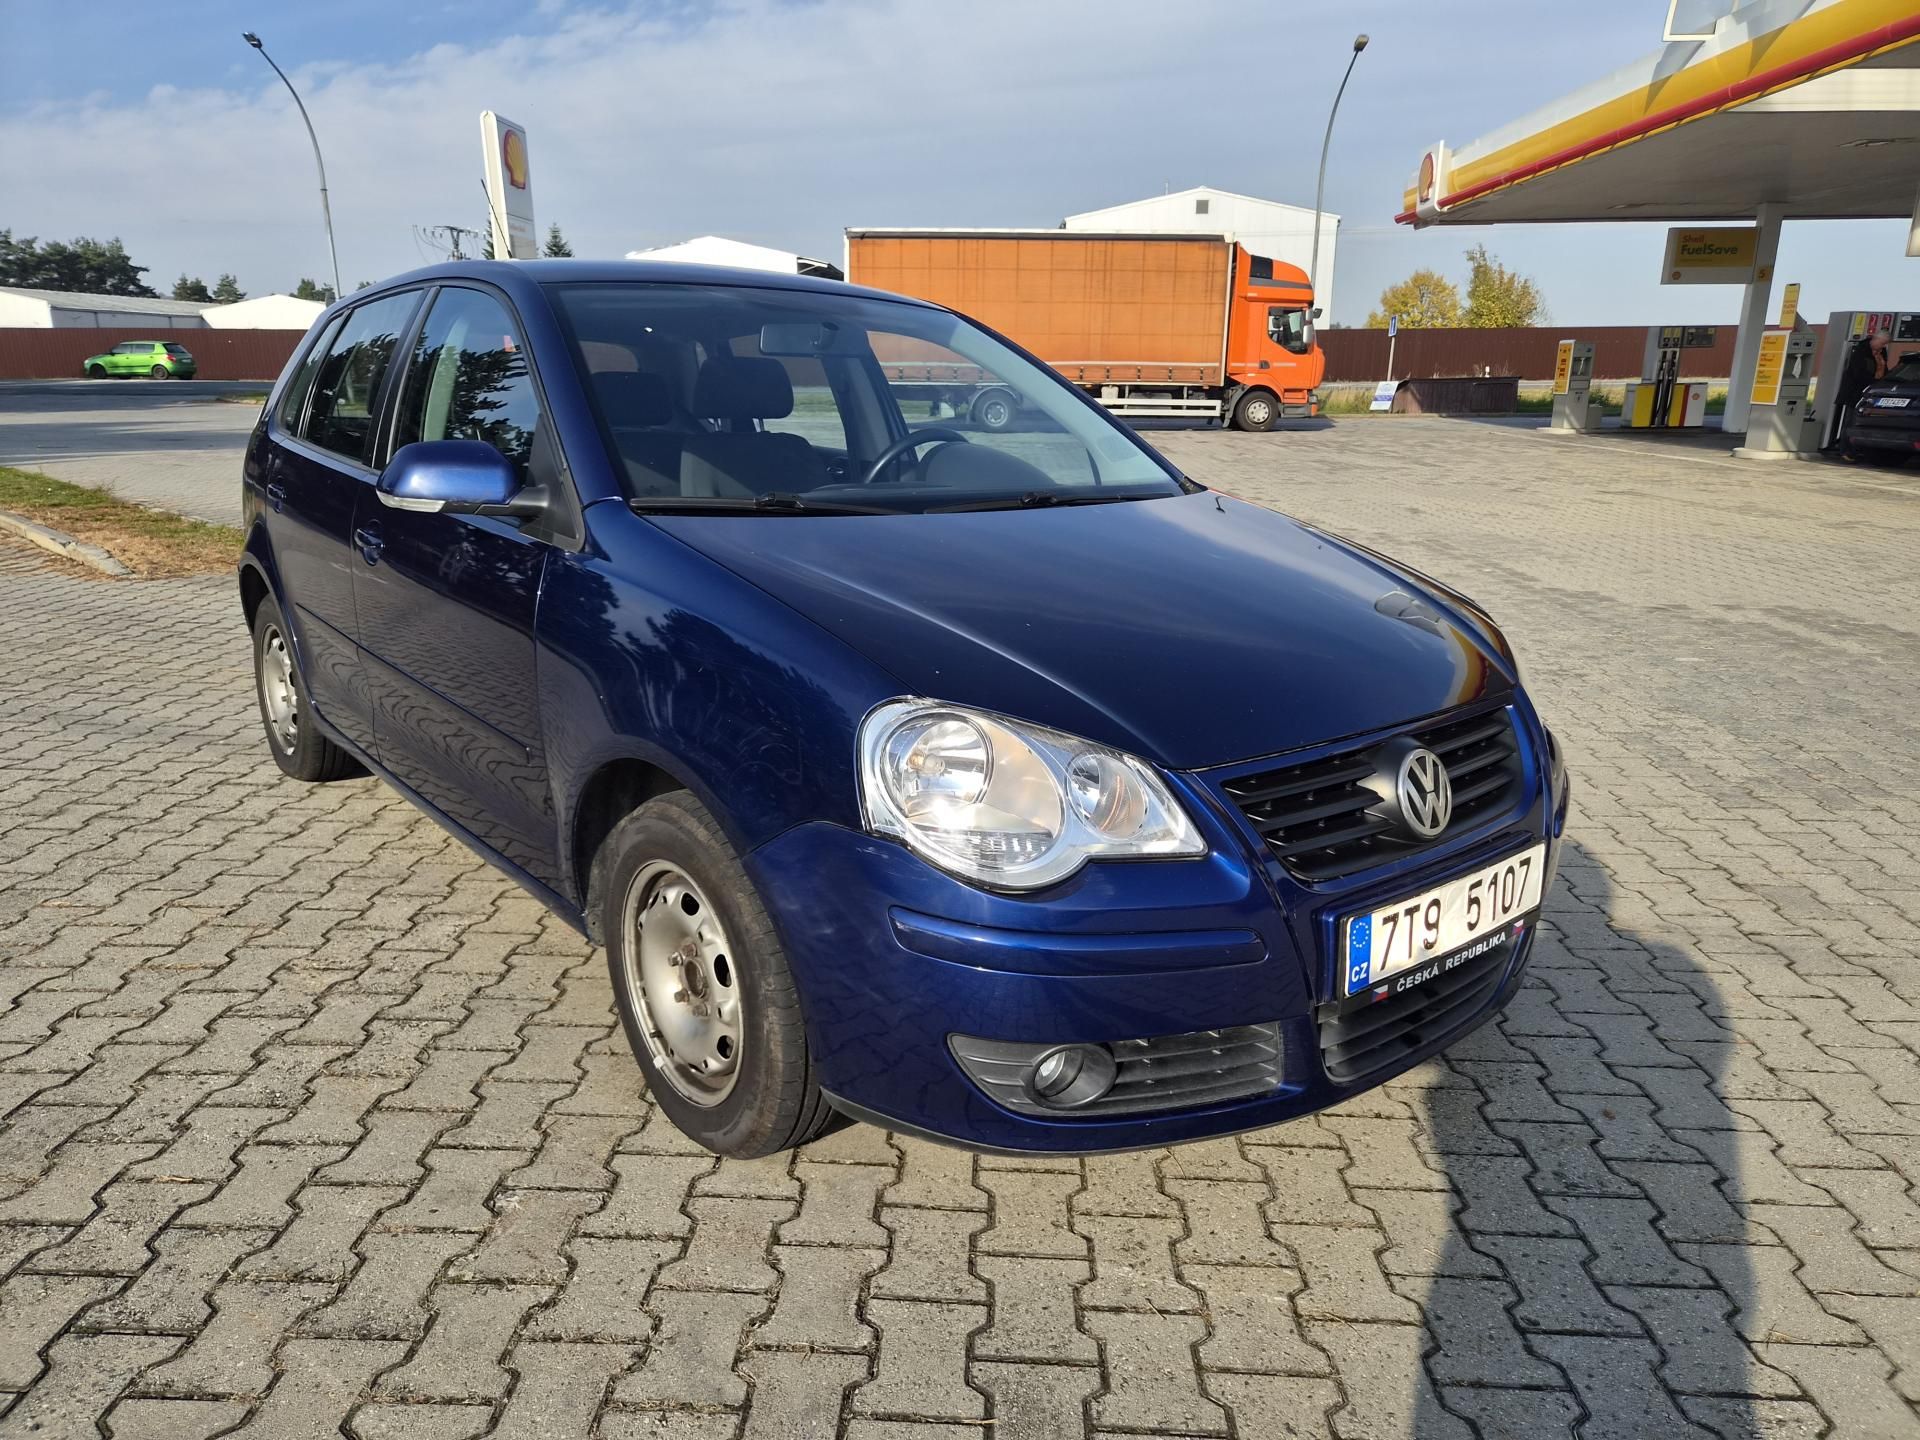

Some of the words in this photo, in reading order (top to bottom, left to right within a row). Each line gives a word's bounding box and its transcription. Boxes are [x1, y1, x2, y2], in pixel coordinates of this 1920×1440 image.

[1682, 234, 1705, 243] Shell
[1680, 244, 1738, 255] FuelSave
[1379, 898, 1441, 971] 7T9
[1466, 856, 1532, 931] 5107
[1396, 961, 1439, 992] ČESKÁ
[1445, 931, 1506, 970] REPUBLIKA
[1351, 963, 1368, 983] CZ
